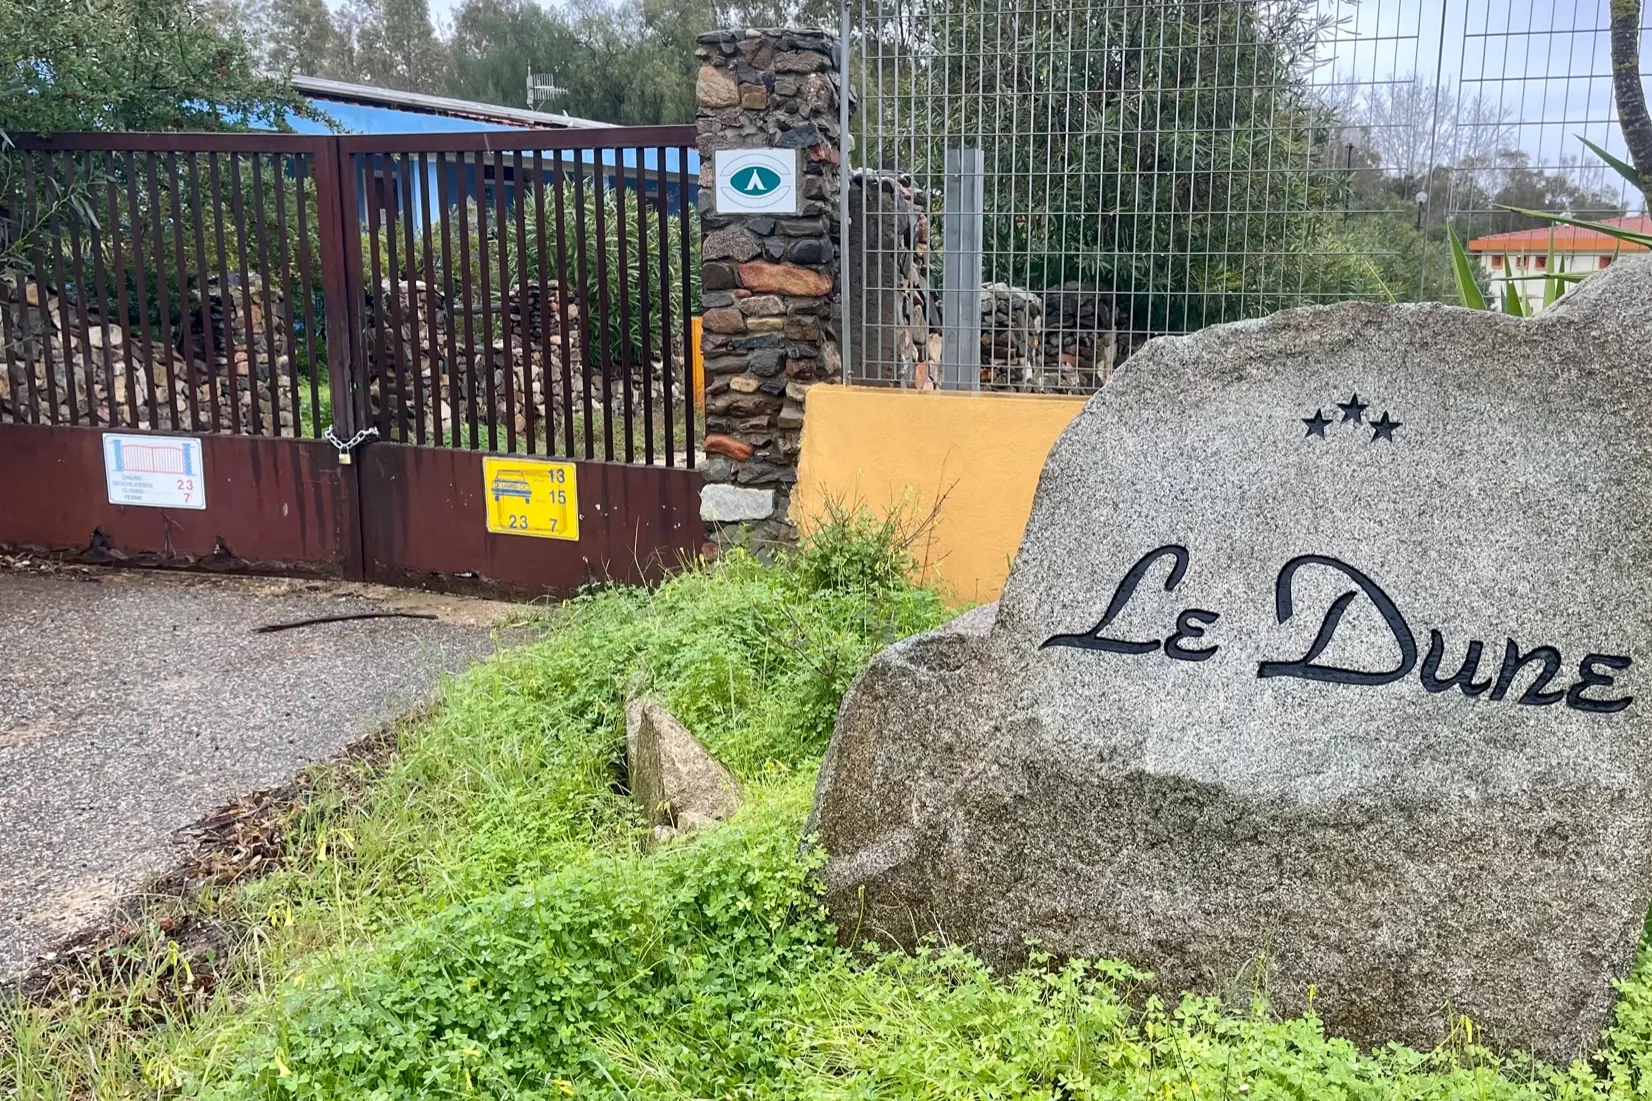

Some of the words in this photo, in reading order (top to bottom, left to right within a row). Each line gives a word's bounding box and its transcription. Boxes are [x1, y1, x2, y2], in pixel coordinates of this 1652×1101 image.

[548, 468, 565, 483] 13
[177, 479, 193, 490] 23
[184, 493, 190, 503] 7
[549, 490, 566, 504] 15
[509, 514, 528, 529] 23
[550, 518, 558, 532] 7
